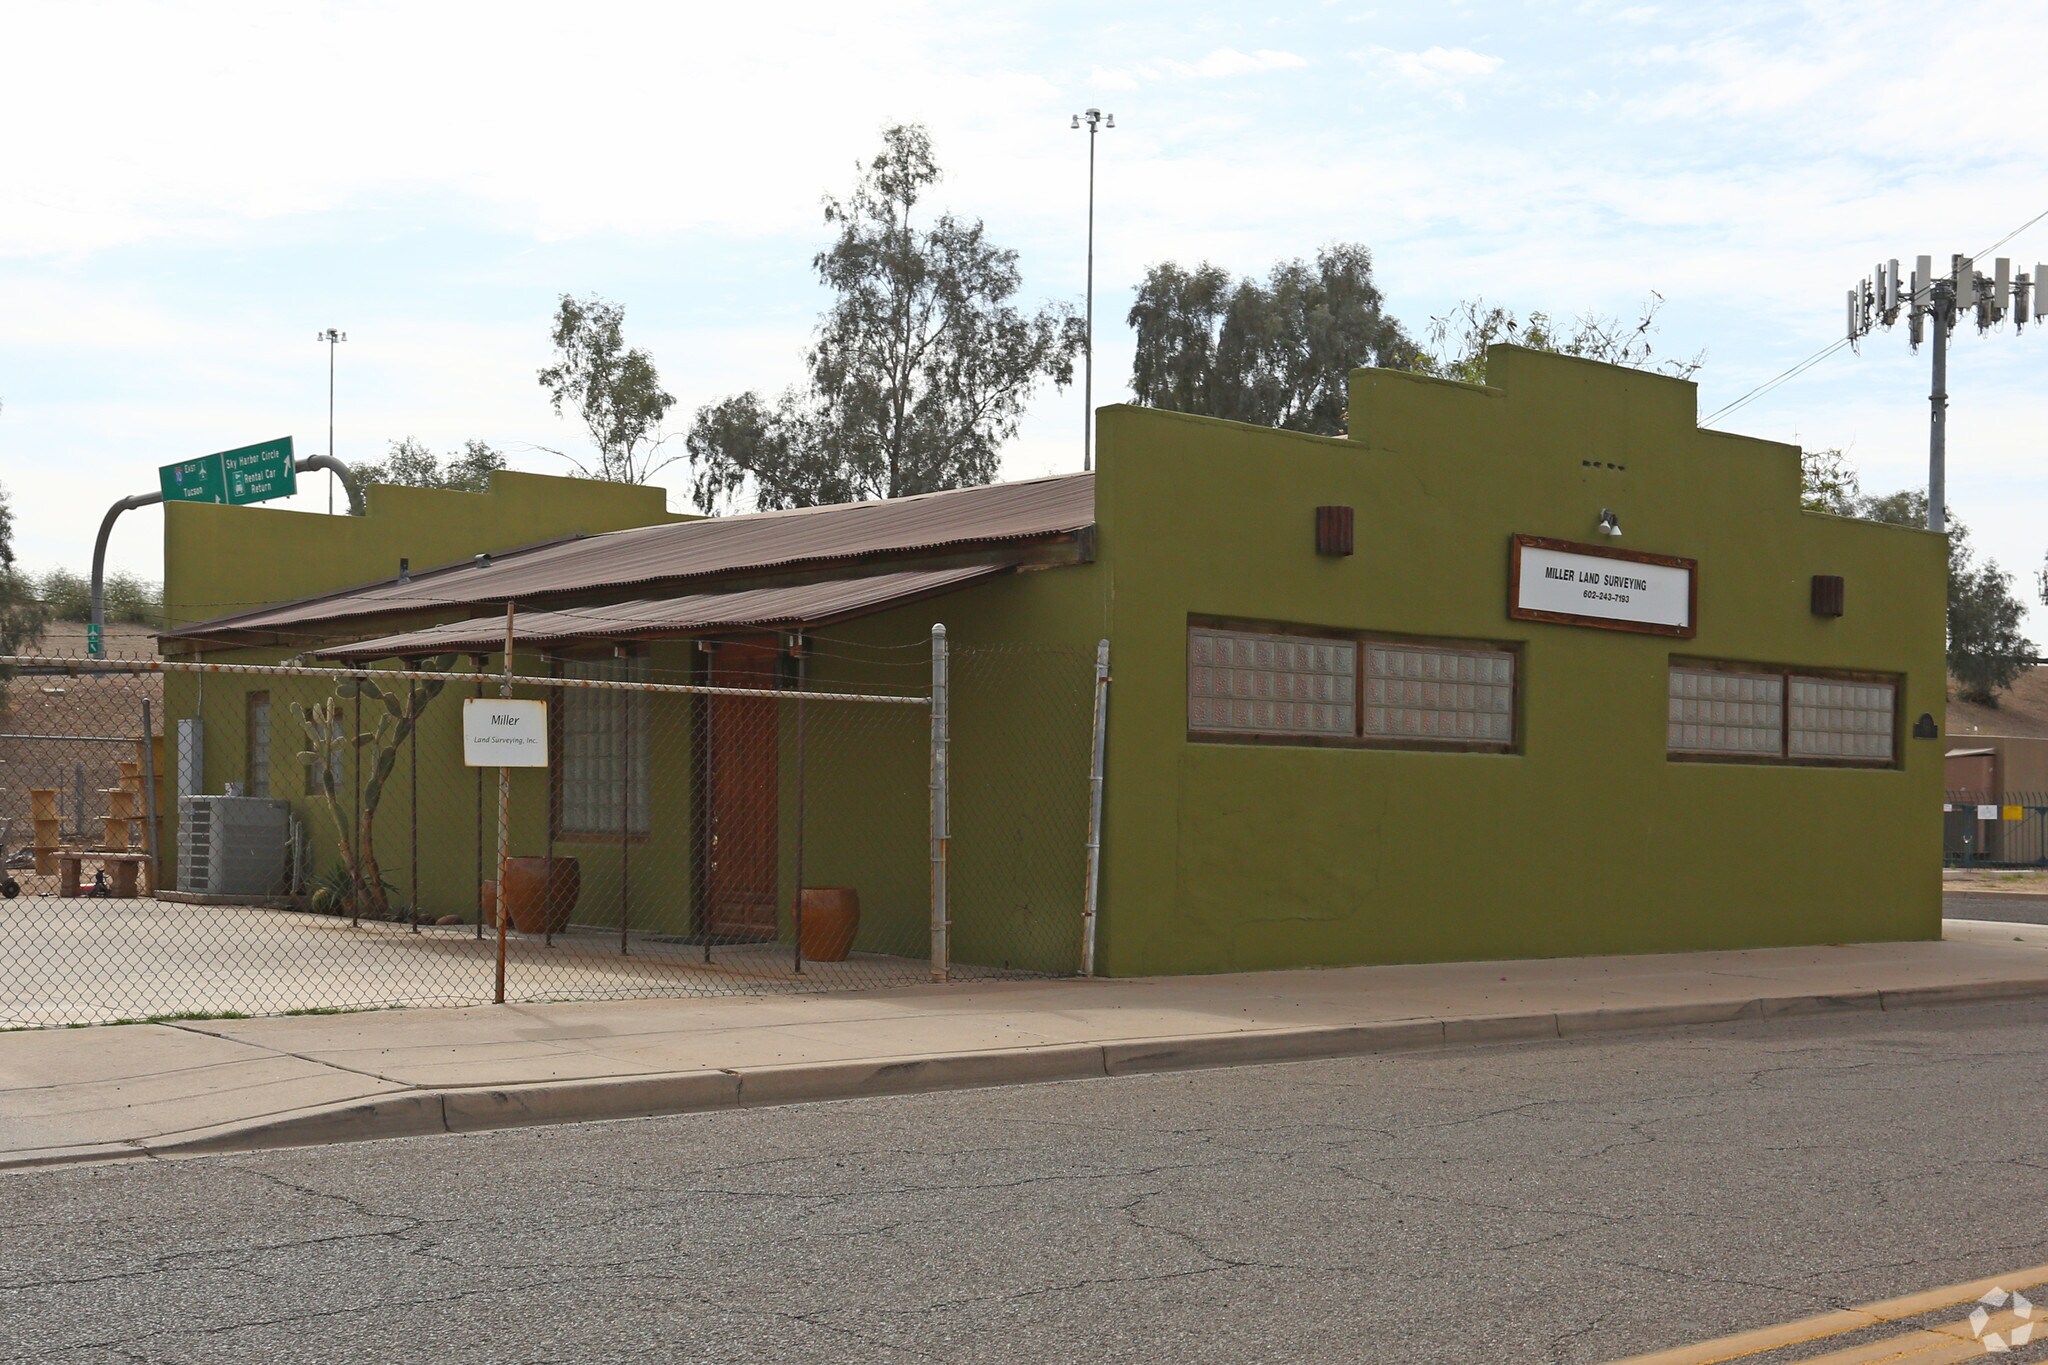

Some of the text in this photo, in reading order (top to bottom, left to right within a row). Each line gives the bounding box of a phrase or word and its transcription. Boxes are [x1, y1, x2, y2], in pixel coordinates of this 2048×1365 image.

[226, 449, 279, 470] Sky Harbor Circle
[244, 469, 276, 483] Rental Car
[183, 486, 203, 497] Tucson
[251, 483, 272, 494] Return
[1545, 567, 1647, 591] MILLER LAND SURVEYING
[1583, 590, 1630, 603] 602-243-7193
[491, 715, 520, 725] Miller
[474, 736, 539, 746] Land Surveying, Inc.
